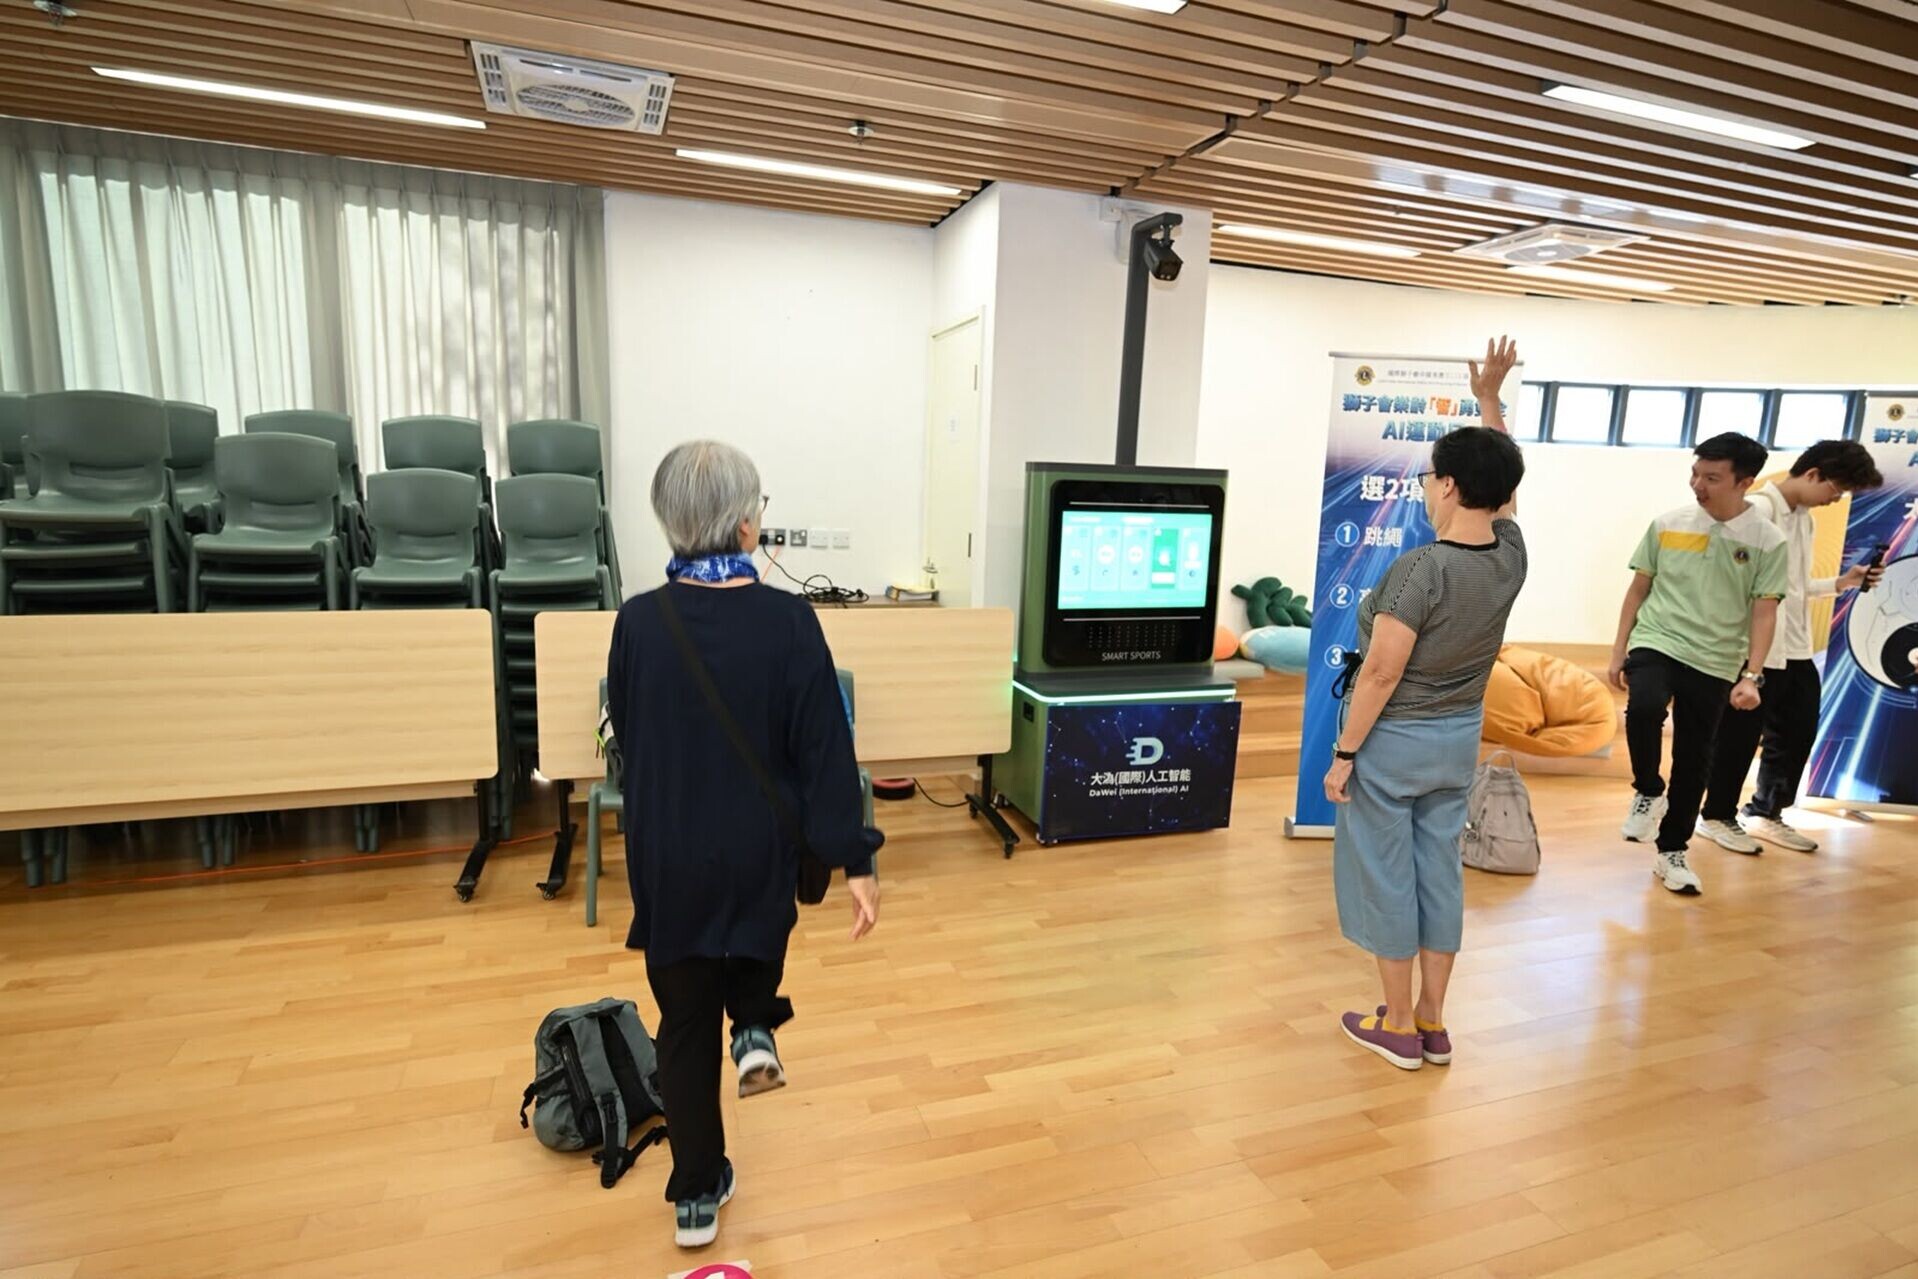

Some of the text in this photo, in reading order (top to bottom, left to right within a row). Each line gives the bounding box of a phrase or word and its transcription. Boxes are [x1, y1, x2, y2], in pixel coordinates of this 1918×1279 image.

[1360, 475, 1424, 503] 選2項
[1363, 526, 1403, 547] 跳繩
[1101, 650, 1161, 661] SMART SPORTS
[1089, 788, 1117, 797] DaWei
[1119, 785, 1178, 796] (International)
